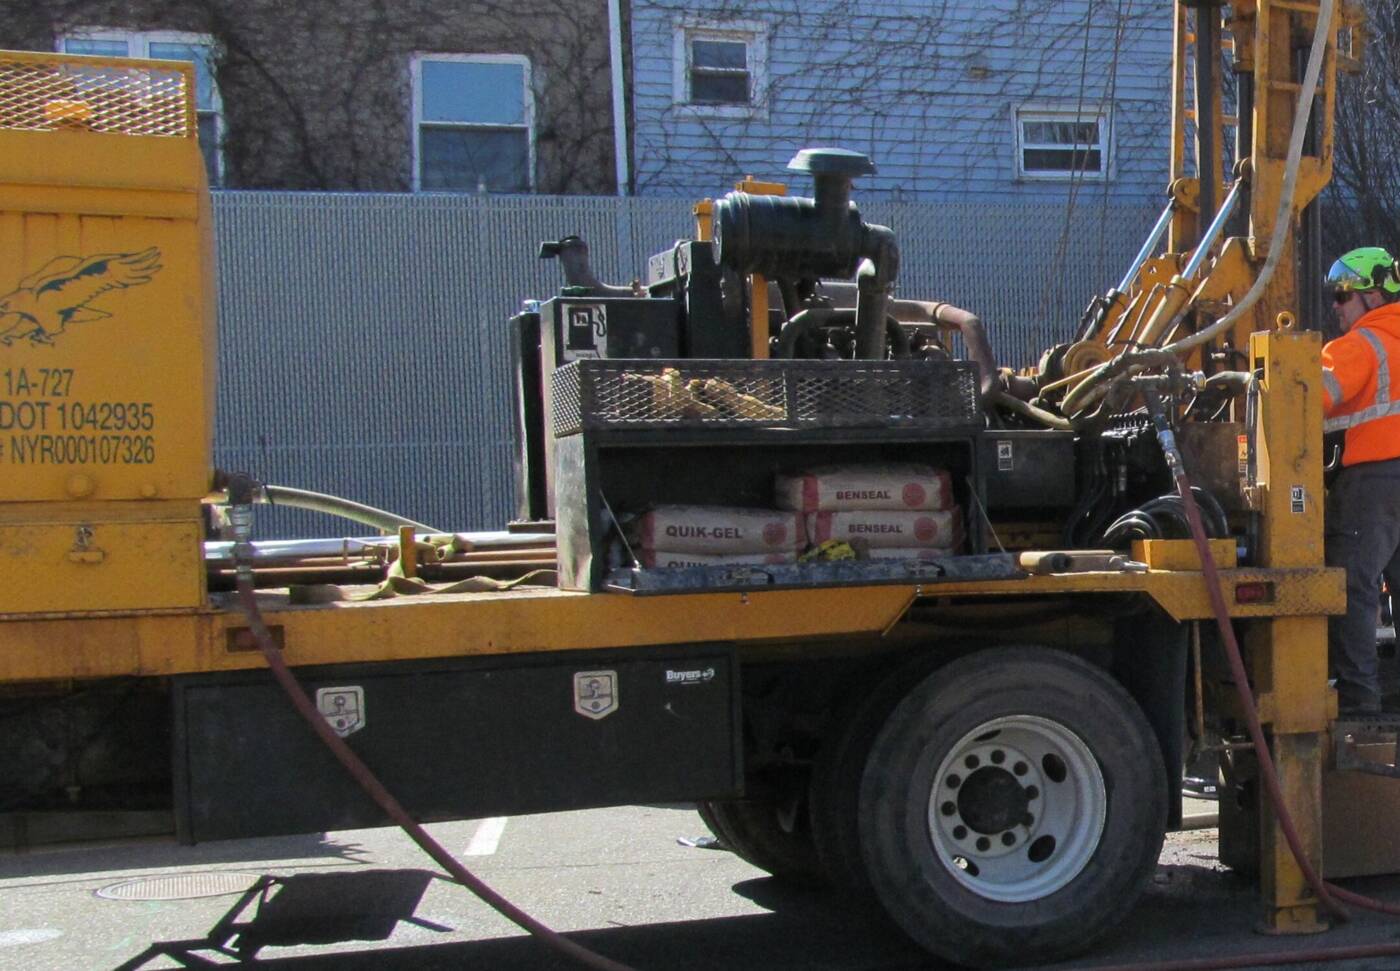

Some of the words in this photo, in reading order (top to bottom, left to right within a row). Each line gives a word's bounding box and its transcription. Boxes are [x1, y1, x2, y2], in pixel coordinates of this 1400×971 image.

[4, 368, 74, 396] 1A-727
[57, 402, 154, 431] 1042935
[11, 435, 155, 464] NYR000107326
[836, 490, 891, 500] BENSEAL
[666, 525, 743, 539] QUIK-GEL
[848, 524, 903, 533] BENSEAL
[666, 670, 701, 681] Buyers
